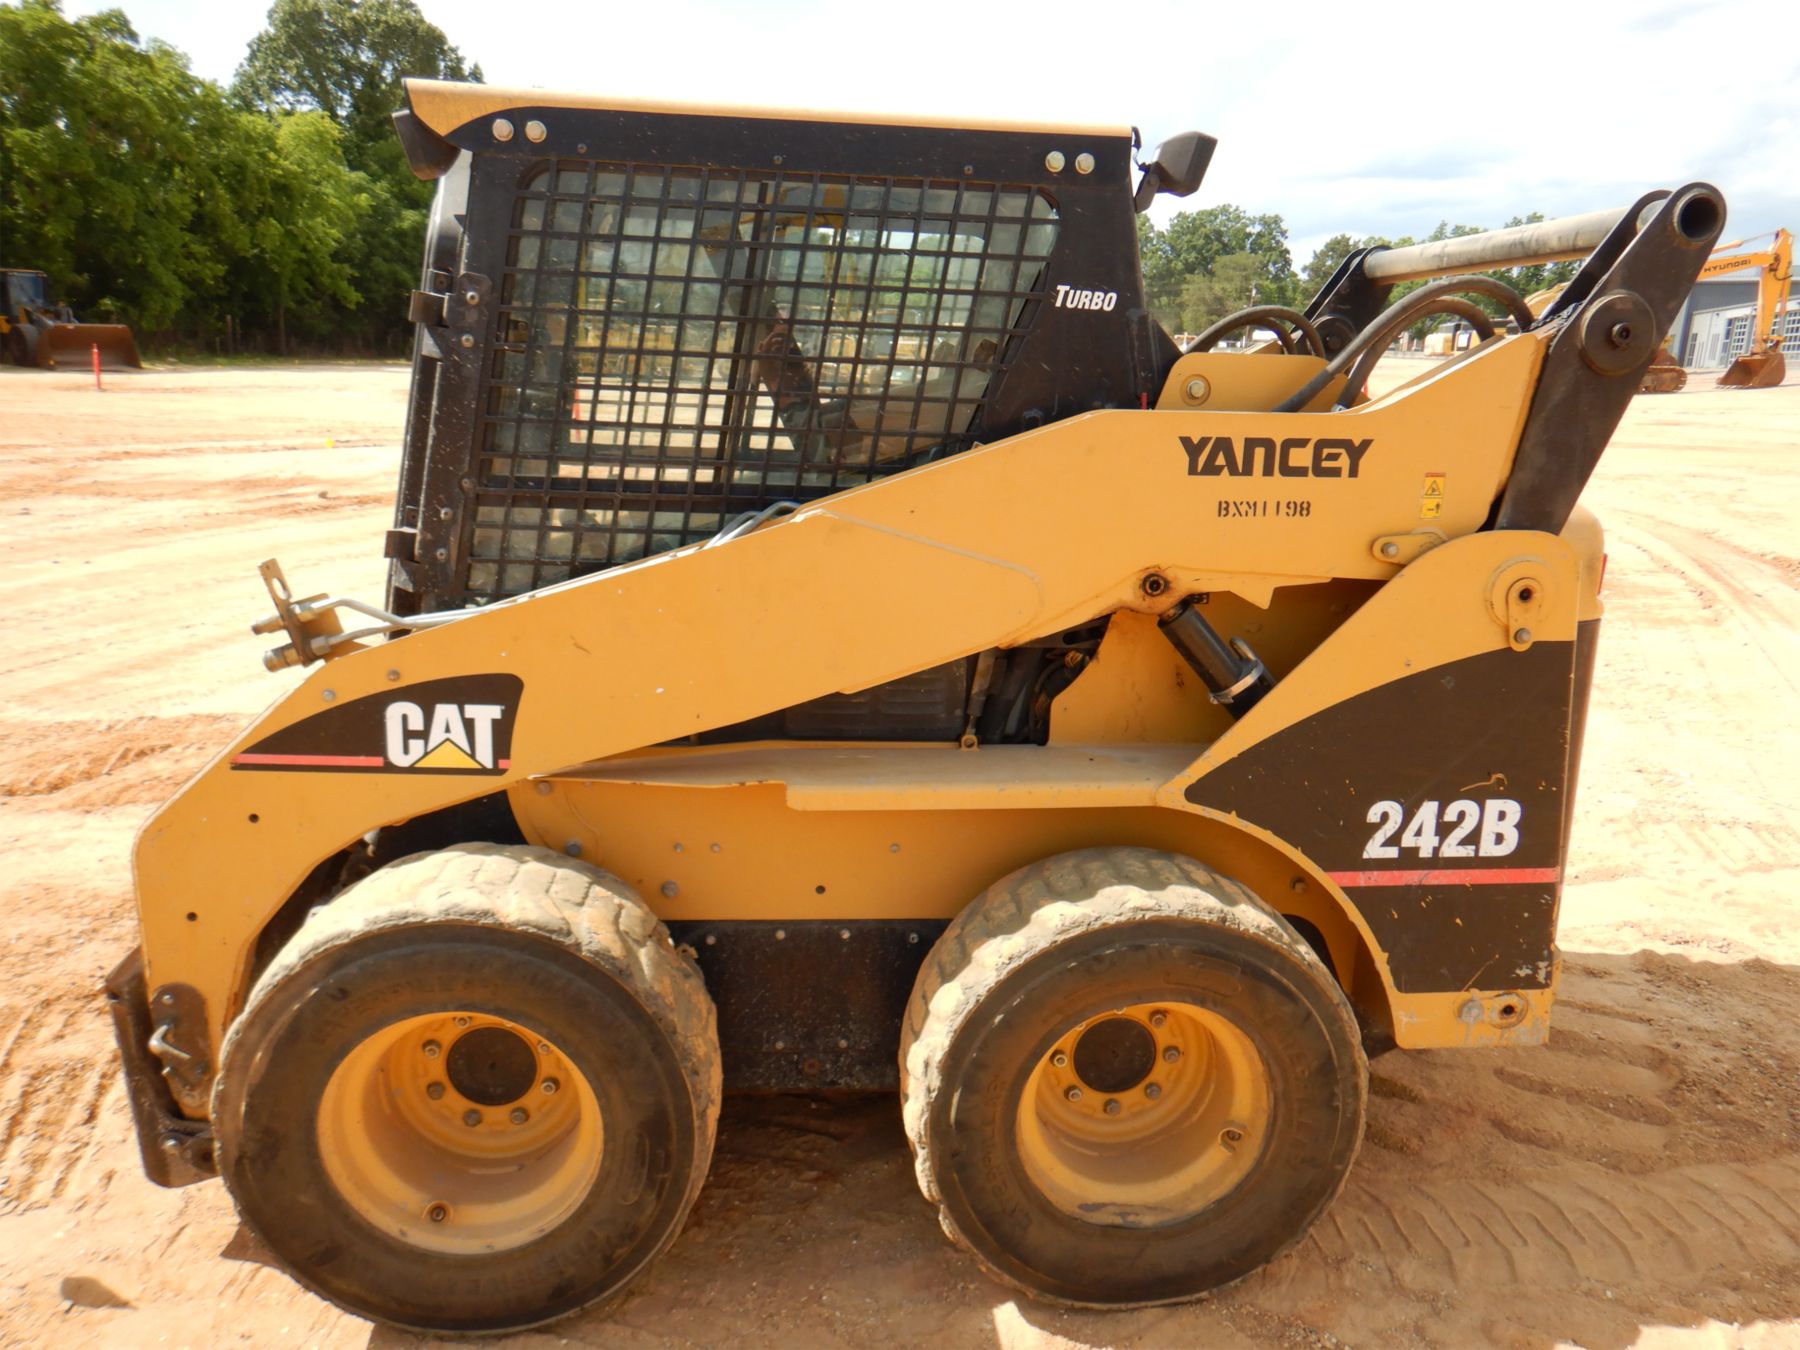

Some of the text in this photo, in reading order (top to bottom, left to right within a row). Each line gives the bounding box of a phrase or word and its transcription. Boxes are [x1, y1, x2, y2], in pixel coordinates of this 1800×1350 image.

[1704, 259, 1751, 272] HYUNDAI
[1055, 285, 1117, 311] TURBO
[1178, 436, 1374, 478] YANCEY
[1218, 500, 1311, 517] BXM1198
[384, 701, 502, 769] CAT
[1362, 799, 1522, 858] 242B
